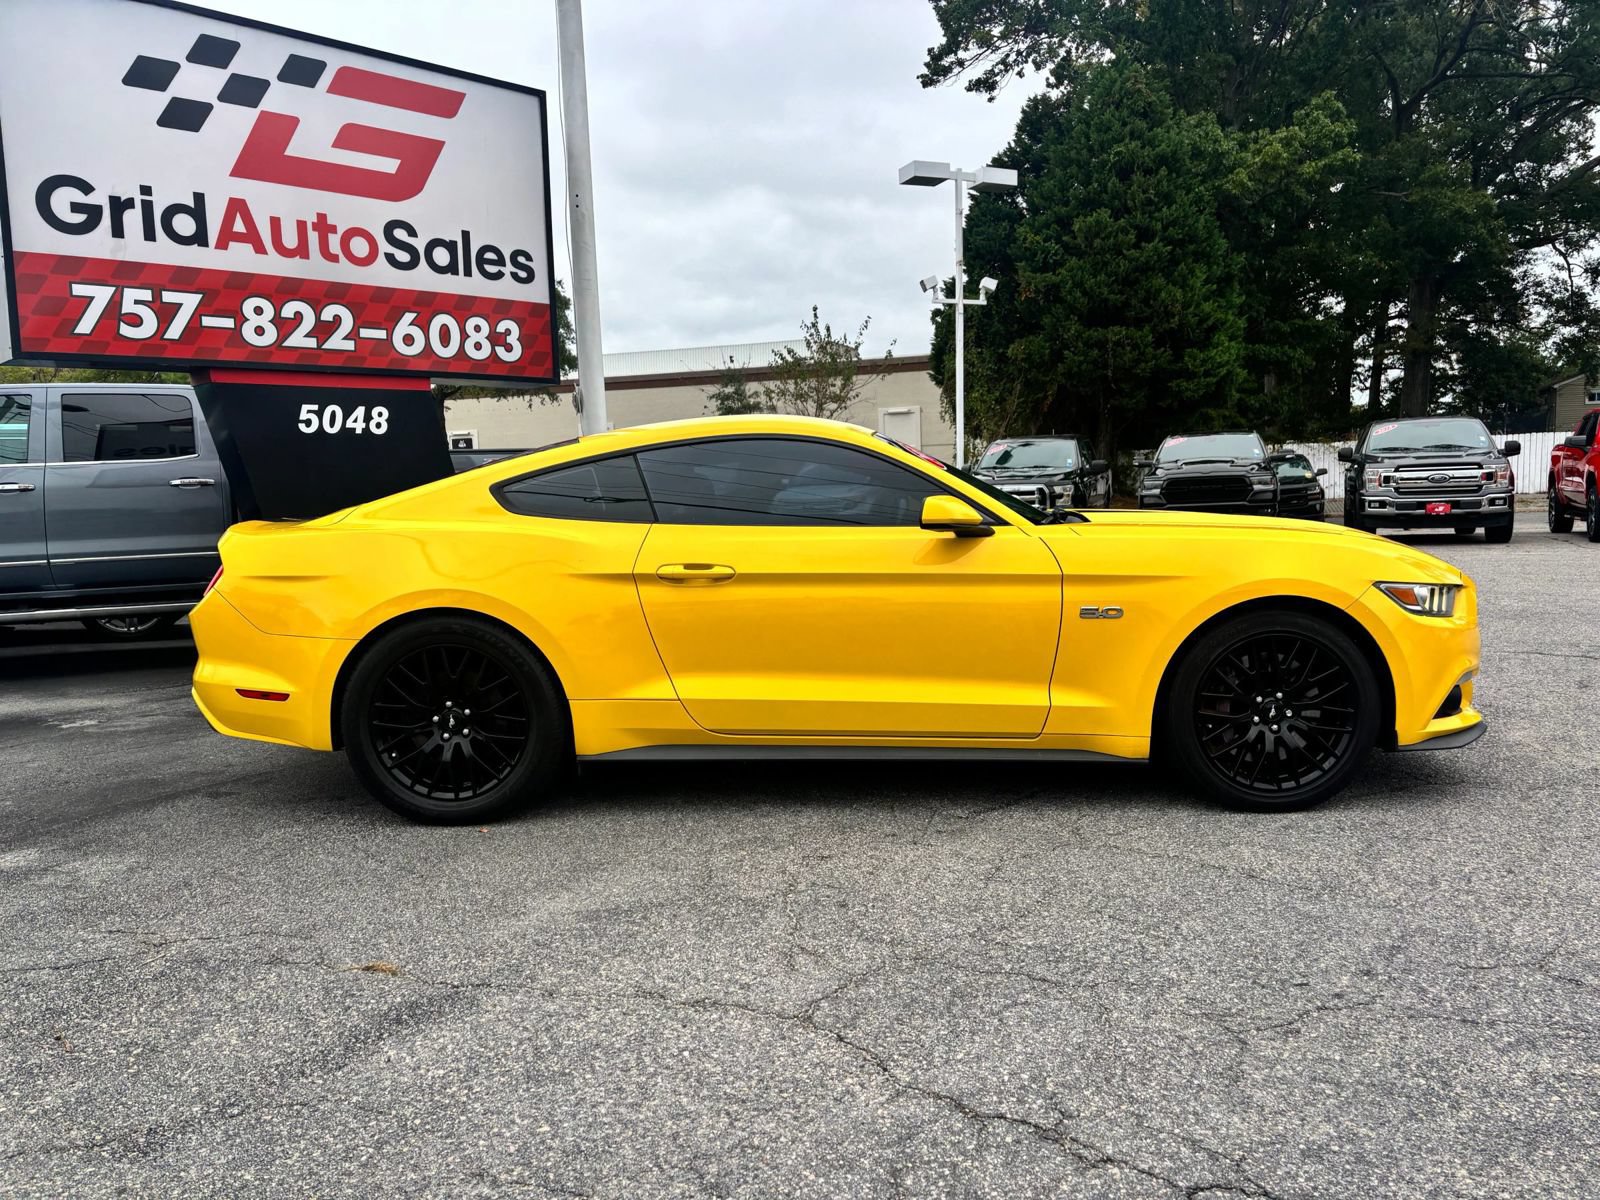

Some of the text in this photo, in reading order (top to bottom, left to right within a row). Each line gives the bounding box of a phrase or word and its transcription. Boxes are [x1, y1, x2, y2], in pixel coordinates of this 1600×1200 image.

[69, 281, 523, 363] 757-822-6083
[298, 404, 389, 435] 5048
[1079, 606, 1124, 619] 5.0
